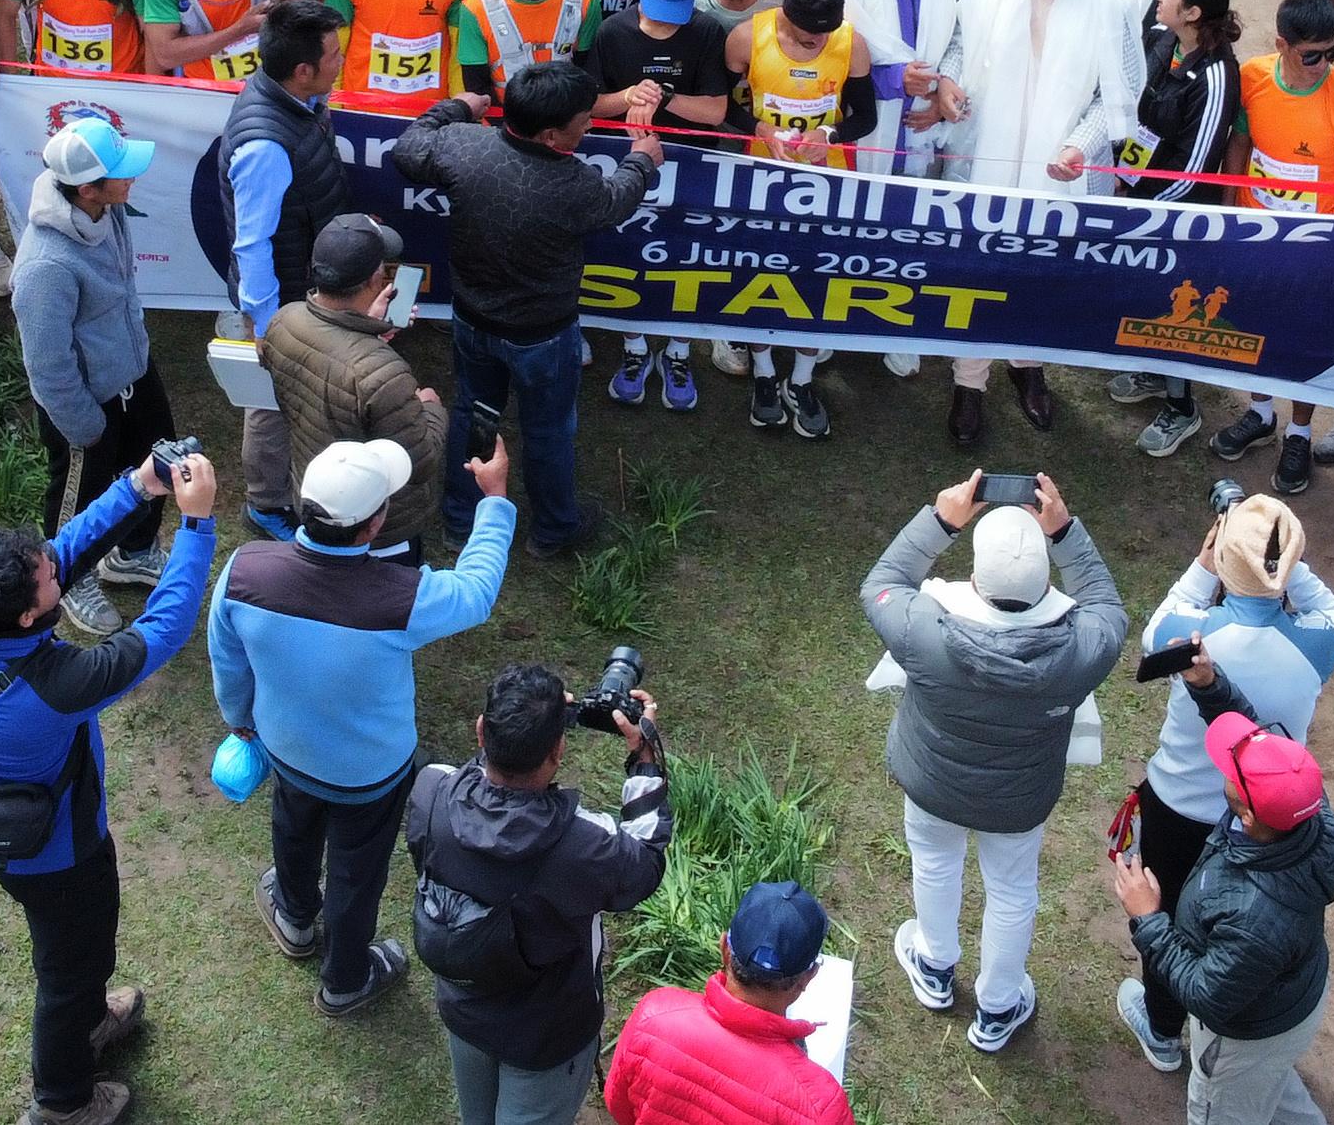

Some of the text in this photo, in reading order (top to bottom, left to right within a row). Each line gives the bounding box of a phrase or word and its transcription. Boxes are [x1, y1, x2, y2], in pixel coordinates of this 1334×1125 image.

[48, 32, 105, 62] 136
[220, 51, 262, 78] 13
[378, 52, 432, 79] 152
[770, 112, 827, 134] 197
[701, 154, 886, 222] Trail
[641, 240, 928, 280] 6 June, 2026
[977, 232, 1059, 258] (32
[1073, 241, 1177, 275] KM)
[578, 264, 1008, 330] START
[1125, 322, 1257, 355] LANGTANG
[1142, 338, 1231, 358] TRAIL RUN
